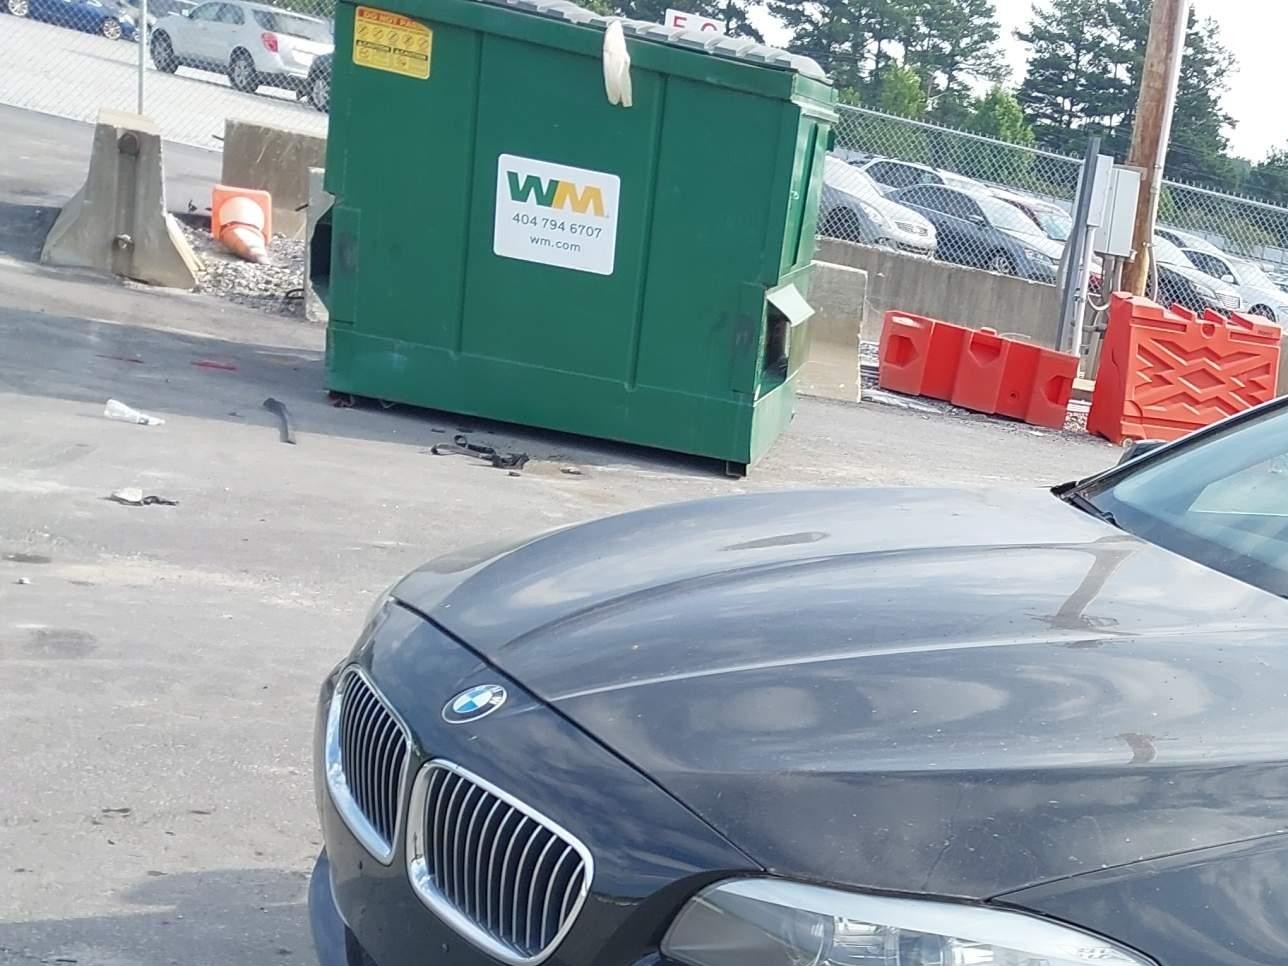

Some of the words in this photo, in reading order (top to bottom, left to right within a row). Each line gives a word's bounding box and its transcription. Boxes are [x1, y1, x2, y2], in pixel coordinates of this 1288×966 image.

[507, 170, 605, 218] WM
[512, 212, 538, 227] 404
[541, 217, 566, 232] 794
[569, 223, 602, 239] 6707
[529, 235, 581, 252] wm.com
